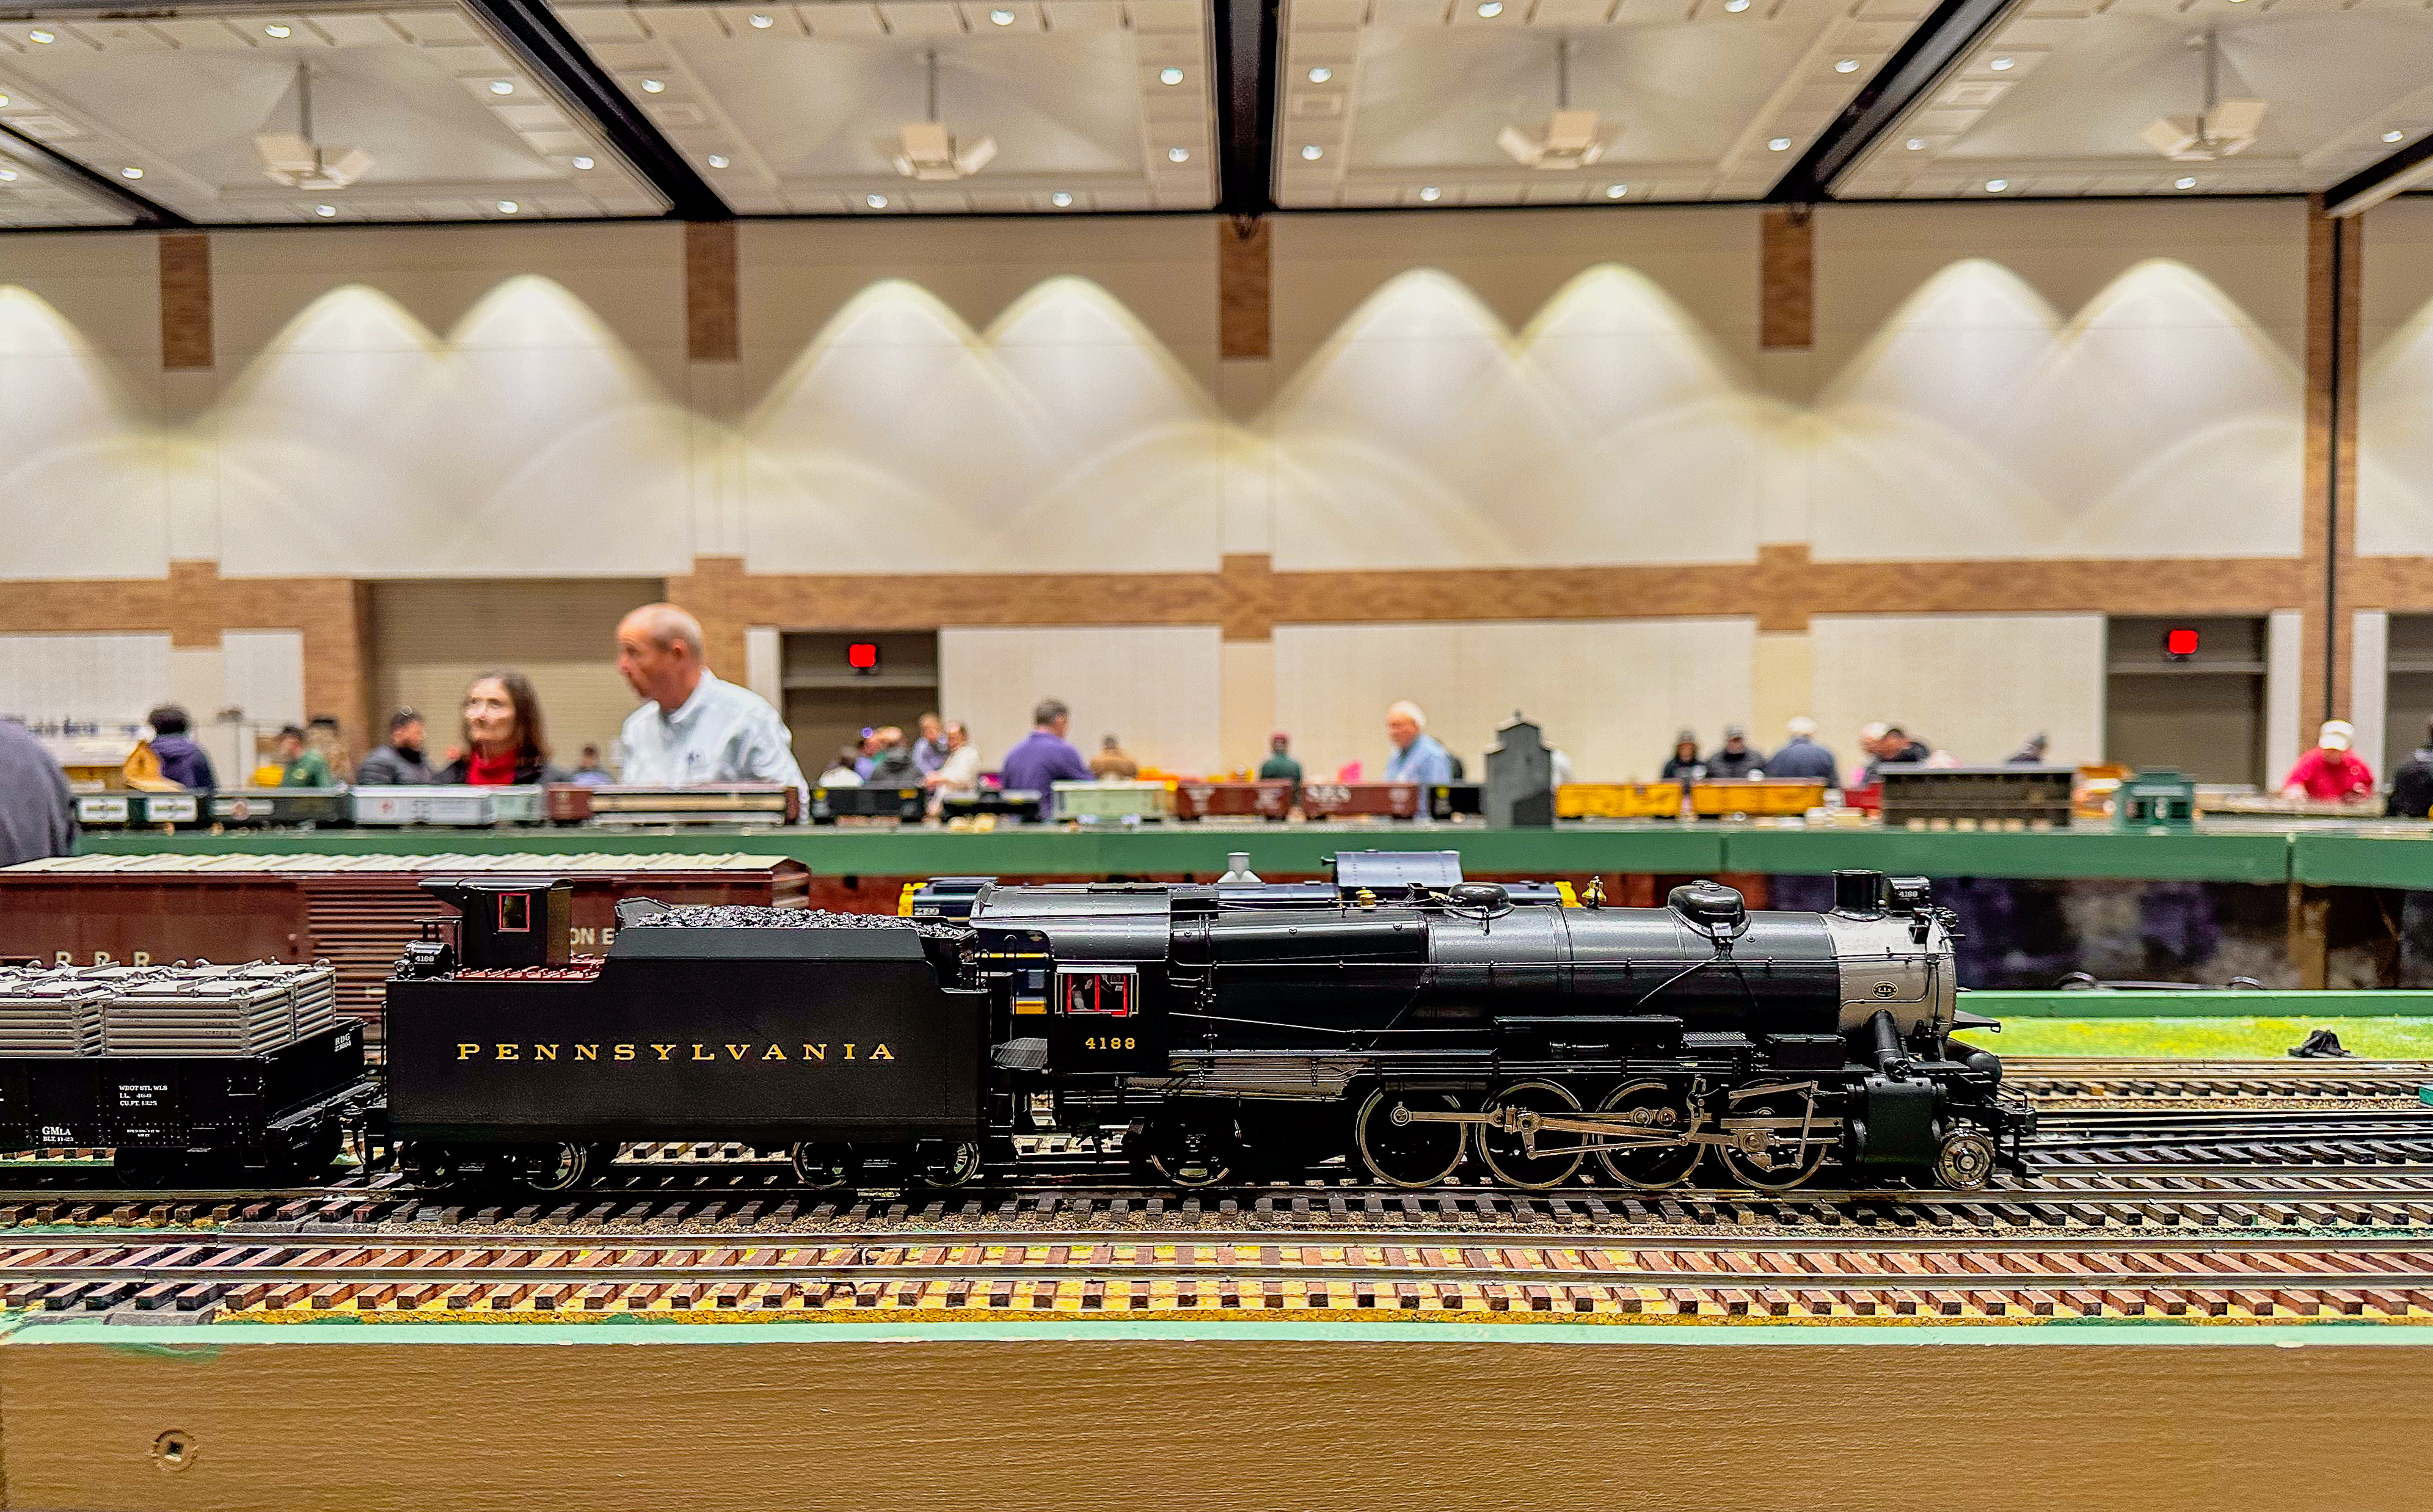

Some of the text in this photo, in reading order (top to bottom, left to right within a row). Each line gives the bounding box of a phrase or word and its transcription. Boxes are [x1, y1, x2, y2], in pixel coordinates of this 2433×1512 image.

[335, 1033, 351, 1046] RDG
[1085, 1037, 1136, 1050] 4188
[457, 1044, 896, 1061] PENNSYLVANIA
